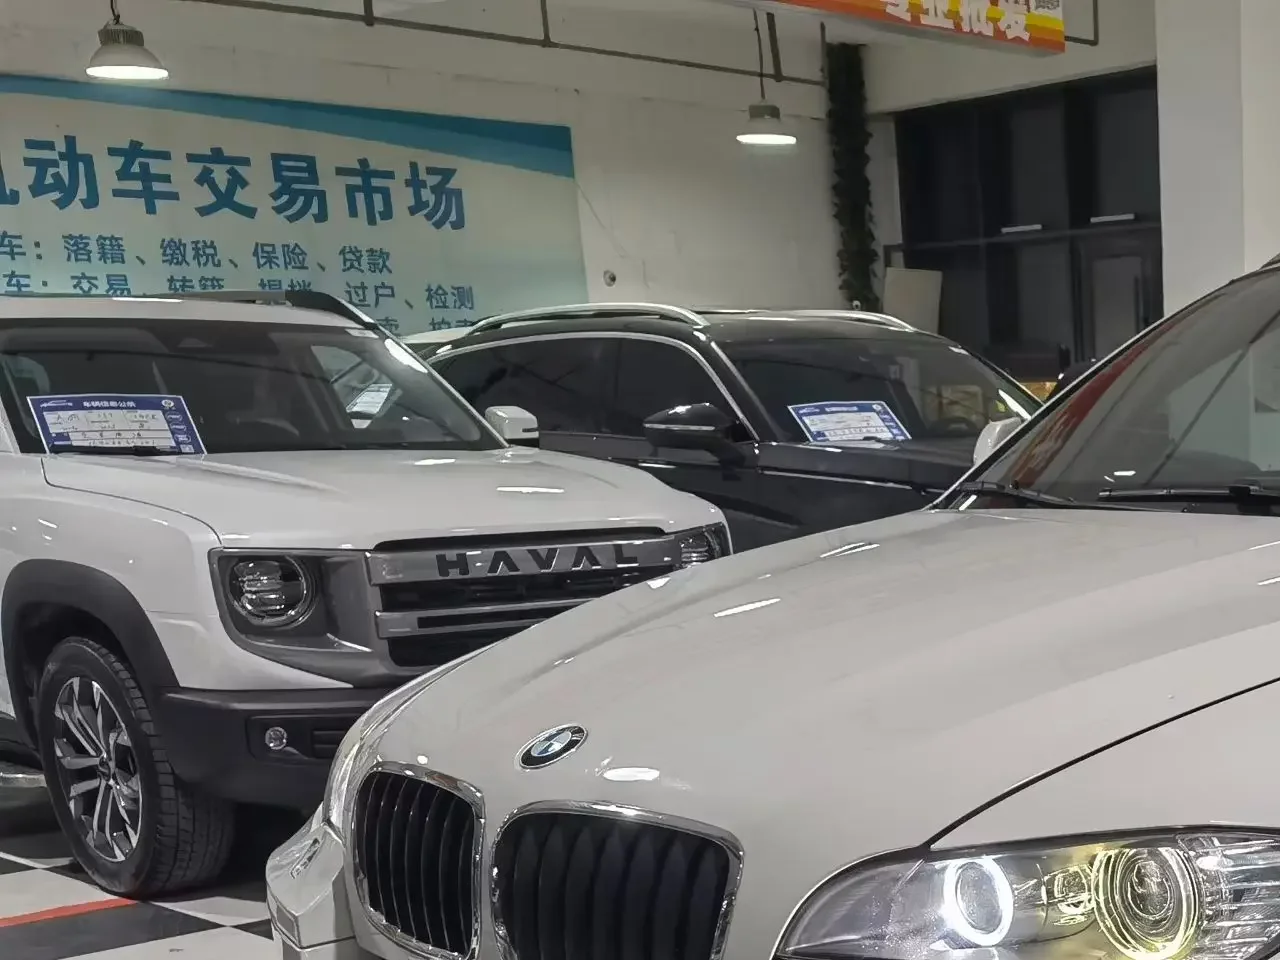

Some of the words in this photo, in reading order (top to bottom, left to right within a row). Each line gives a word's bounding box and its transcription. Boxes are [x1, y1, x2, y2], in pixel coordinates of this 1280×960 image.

[0, 135, 466, 231] 动车交易市场
[435, 543, 640, 578] HAVAL
